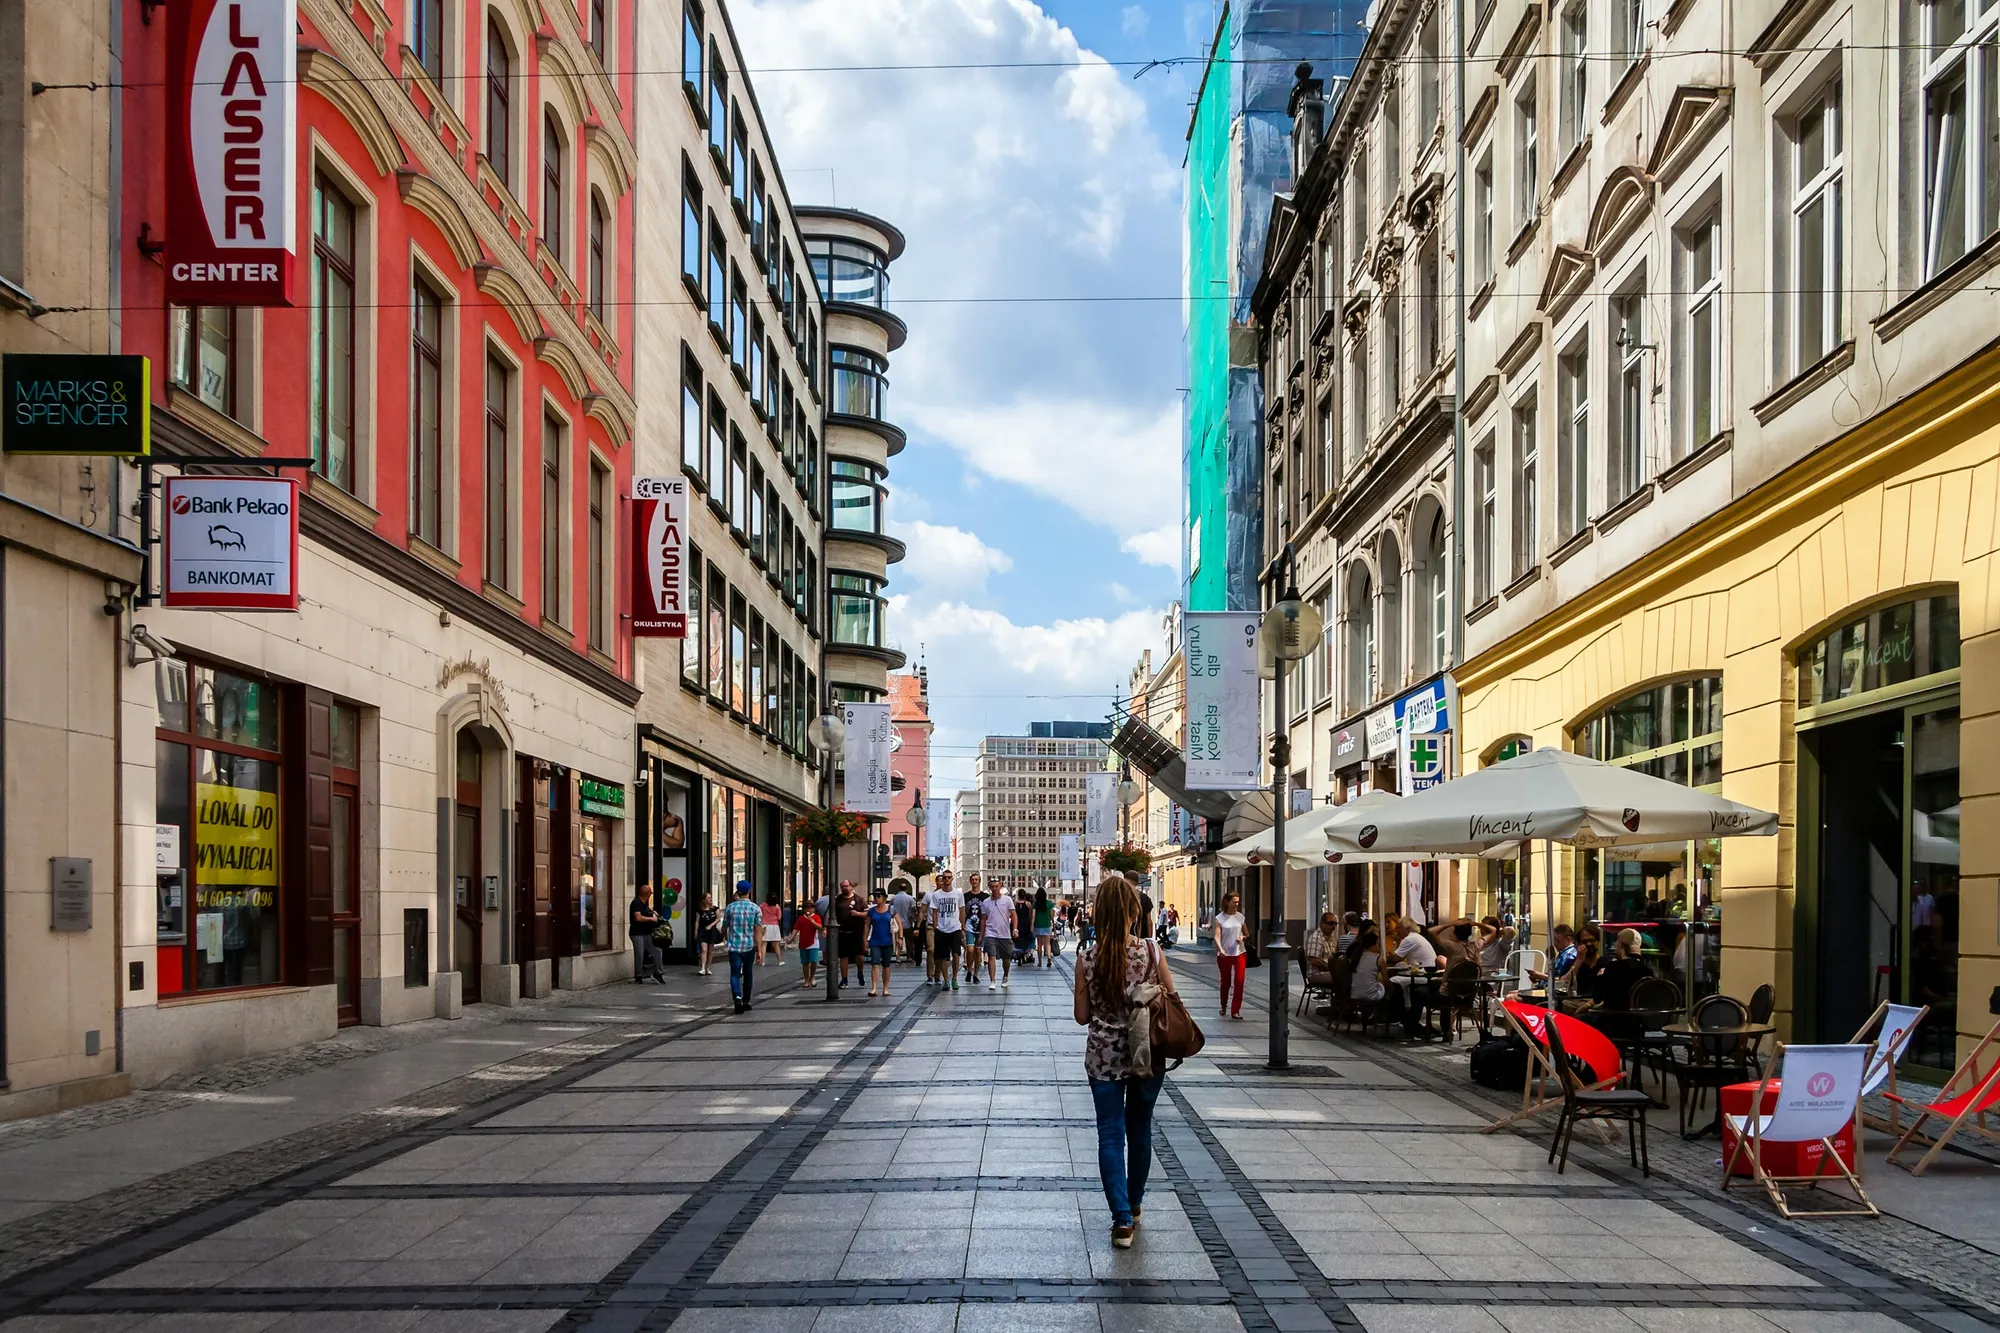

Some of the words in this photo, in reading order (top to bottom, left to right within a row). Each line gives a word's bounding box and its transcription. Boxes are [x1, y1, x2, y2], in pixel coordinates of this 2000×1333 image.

[220, 3, 268, 240] LASER
[172, 263, 279, 282] CENTER
[16, 403, 128, 426] SPENCER
[652, 483, 683, 494] EYE
[192, 497, 234, 514] Bank
[236, 497, 289, 516] Pekao
[660, 502, 682, 611] LASER
[188, 570, 276, 587] BANKOMAT
[634, 621, 683, 629] OKULISTYKA
[1413, 696, 1435, 721] APTEKA
[868, 728, 877, 743] dla
[878, 711, 890, 743] Kultury
[868, 759, 879, 794] Koalicja
[199, 799, 249, 828] LOKAL
[252, 805, 273, 830] DO
[1469, 811, 1536, 840] Vincent
[1707, 810, 1751, 832] Vincent
[251, 890, 273, 907] 096
